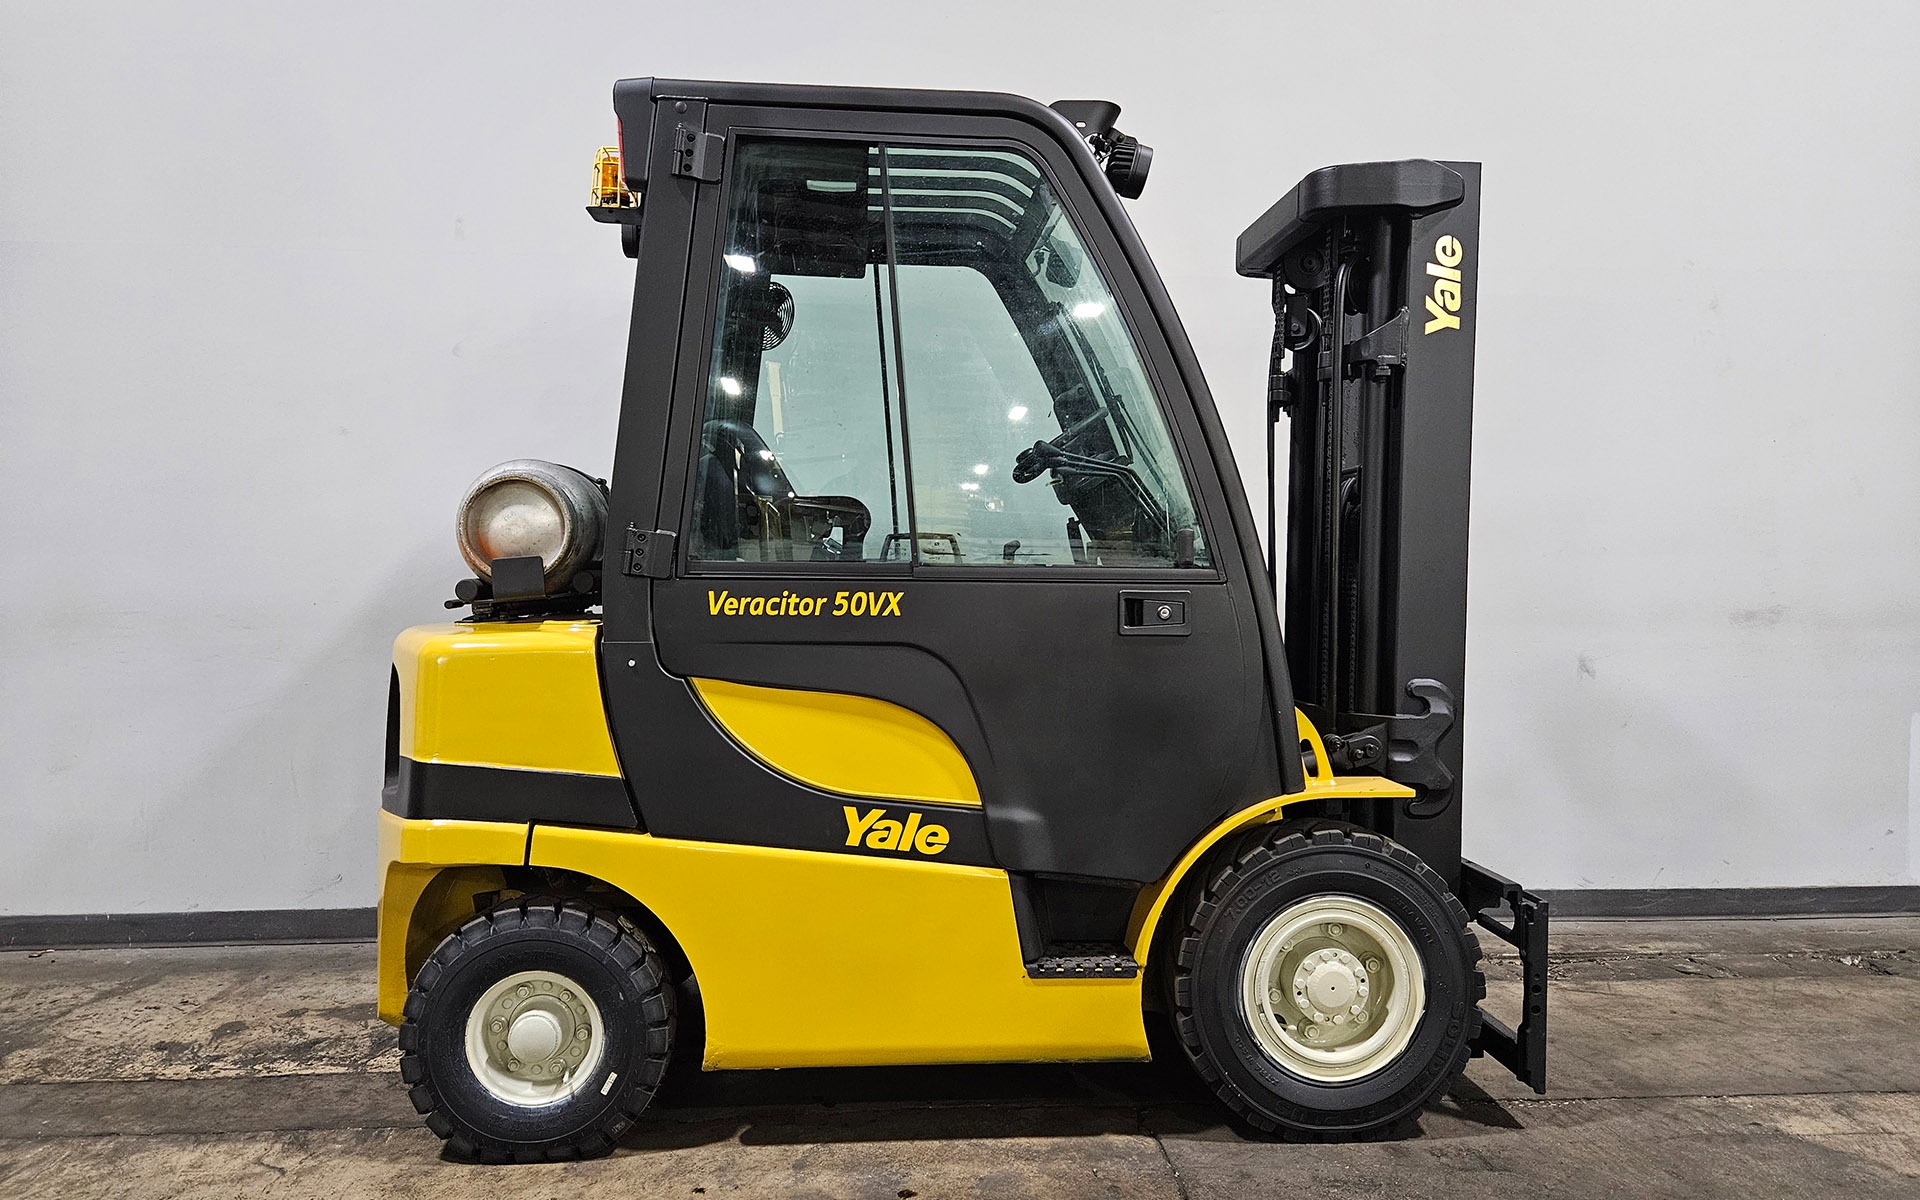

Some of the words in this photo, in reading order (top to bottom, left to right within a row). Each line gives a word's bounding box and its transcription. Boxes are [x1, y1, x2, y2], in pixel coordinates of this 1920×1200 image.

[1424, 234, 1463, 335] Yale
[708, 590, 827, 616] Veracitor
[832, 591, 904, 617] 50VX
[843, 805, 950, 855] Yale
